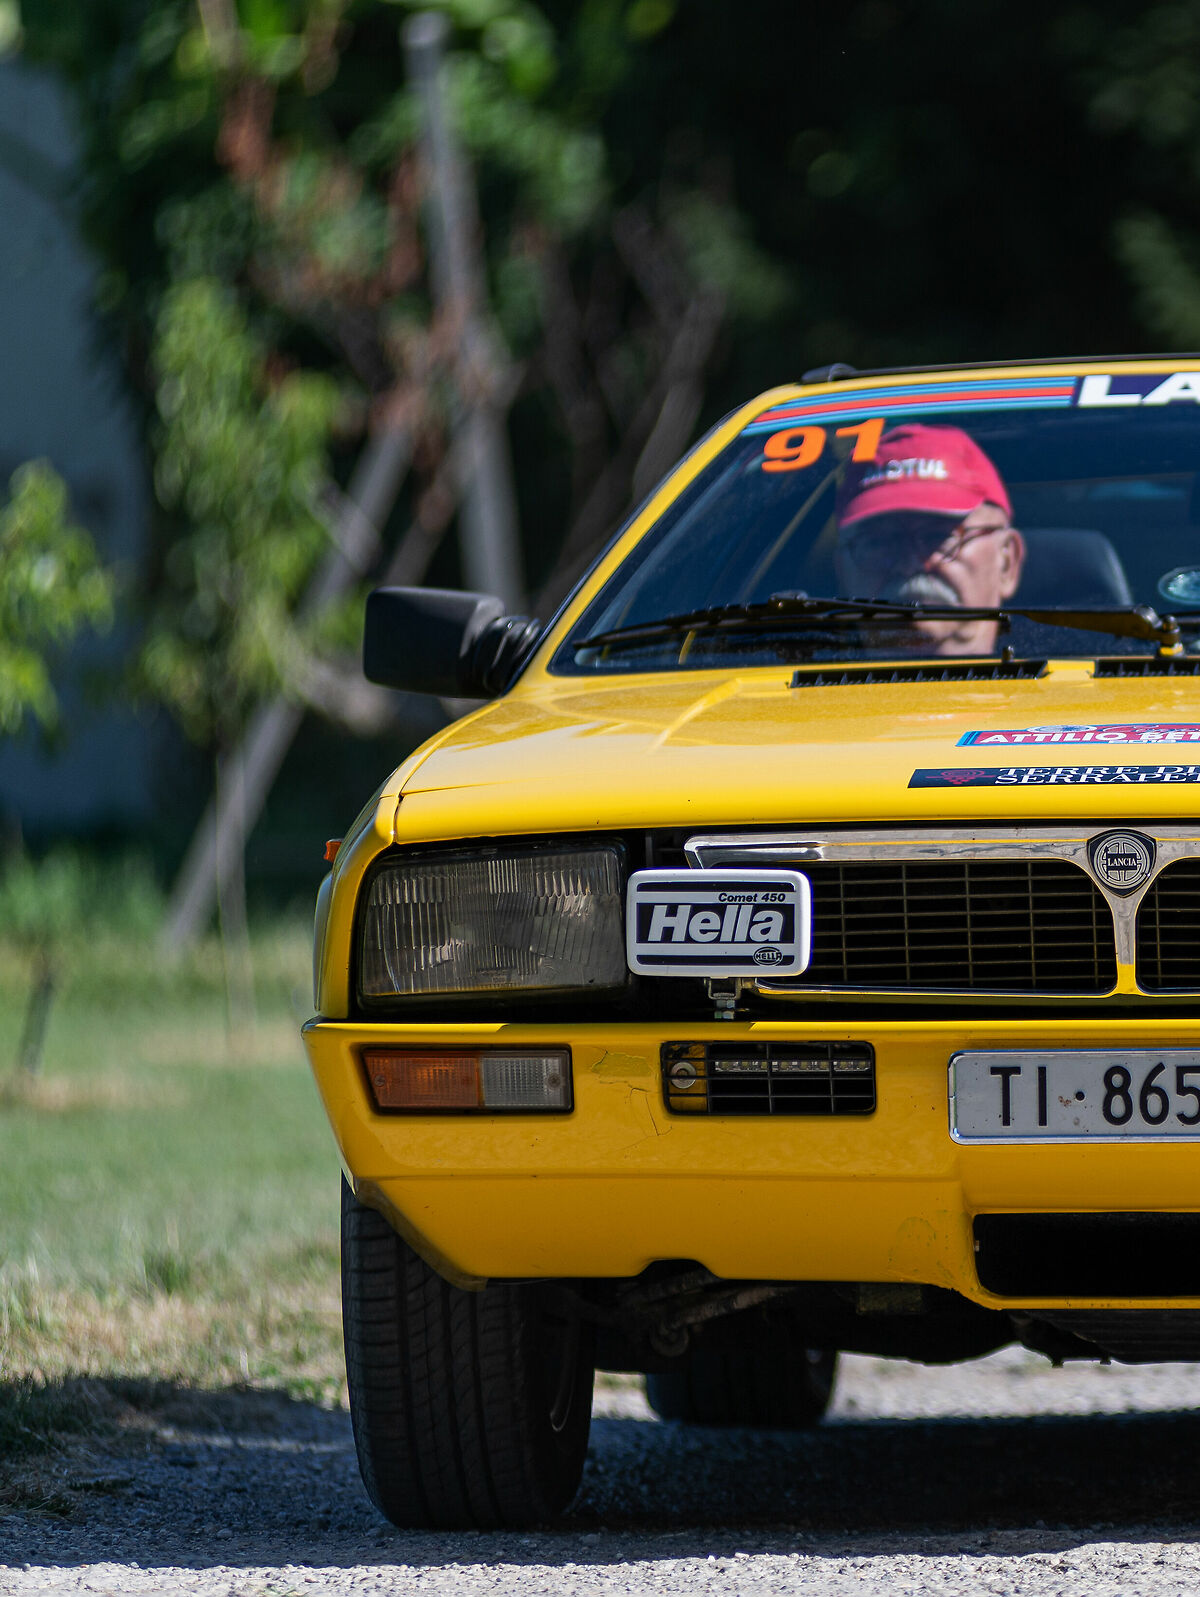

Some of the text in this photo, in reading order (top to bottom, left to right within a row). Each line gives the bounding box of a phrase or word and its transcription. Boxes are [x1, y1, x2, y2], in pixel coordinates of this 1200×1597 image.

[761, 418, 886, 473] 91
[980, 732, 1127, 744] ATTILIO
[1000, 766, 1200, 777] TERRE DI
[1107, 857, 1137, 867] LANCIA
[718, 893, 786, 903] Comet 450
[647, 904, 784, 943] Hella
[755, 950, 783, 961] HELLA
